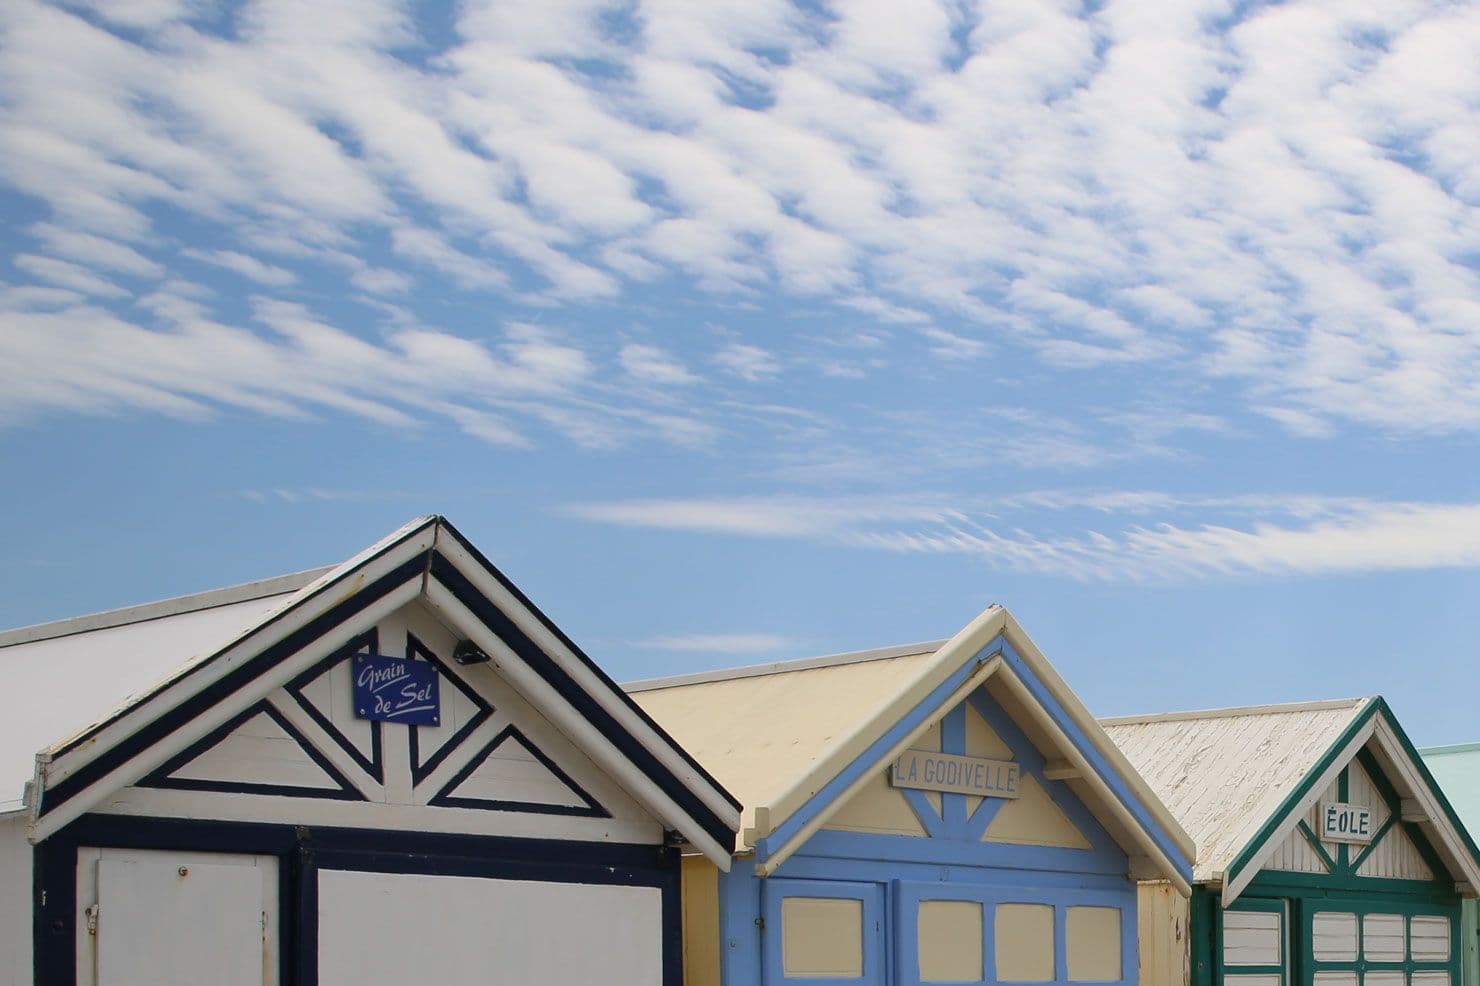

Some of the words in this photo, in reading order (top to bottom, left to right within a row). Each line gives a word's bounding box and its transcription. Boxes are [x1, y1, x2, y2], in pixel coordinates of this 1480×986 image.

[357, 663, 405, 691] Grain
[374, 695, 392, 714] de
[395, 682, 432, 709] Sel
[895, 756, 918, 782] LA
[924, 758, 1018, 793] GODIVELLE
